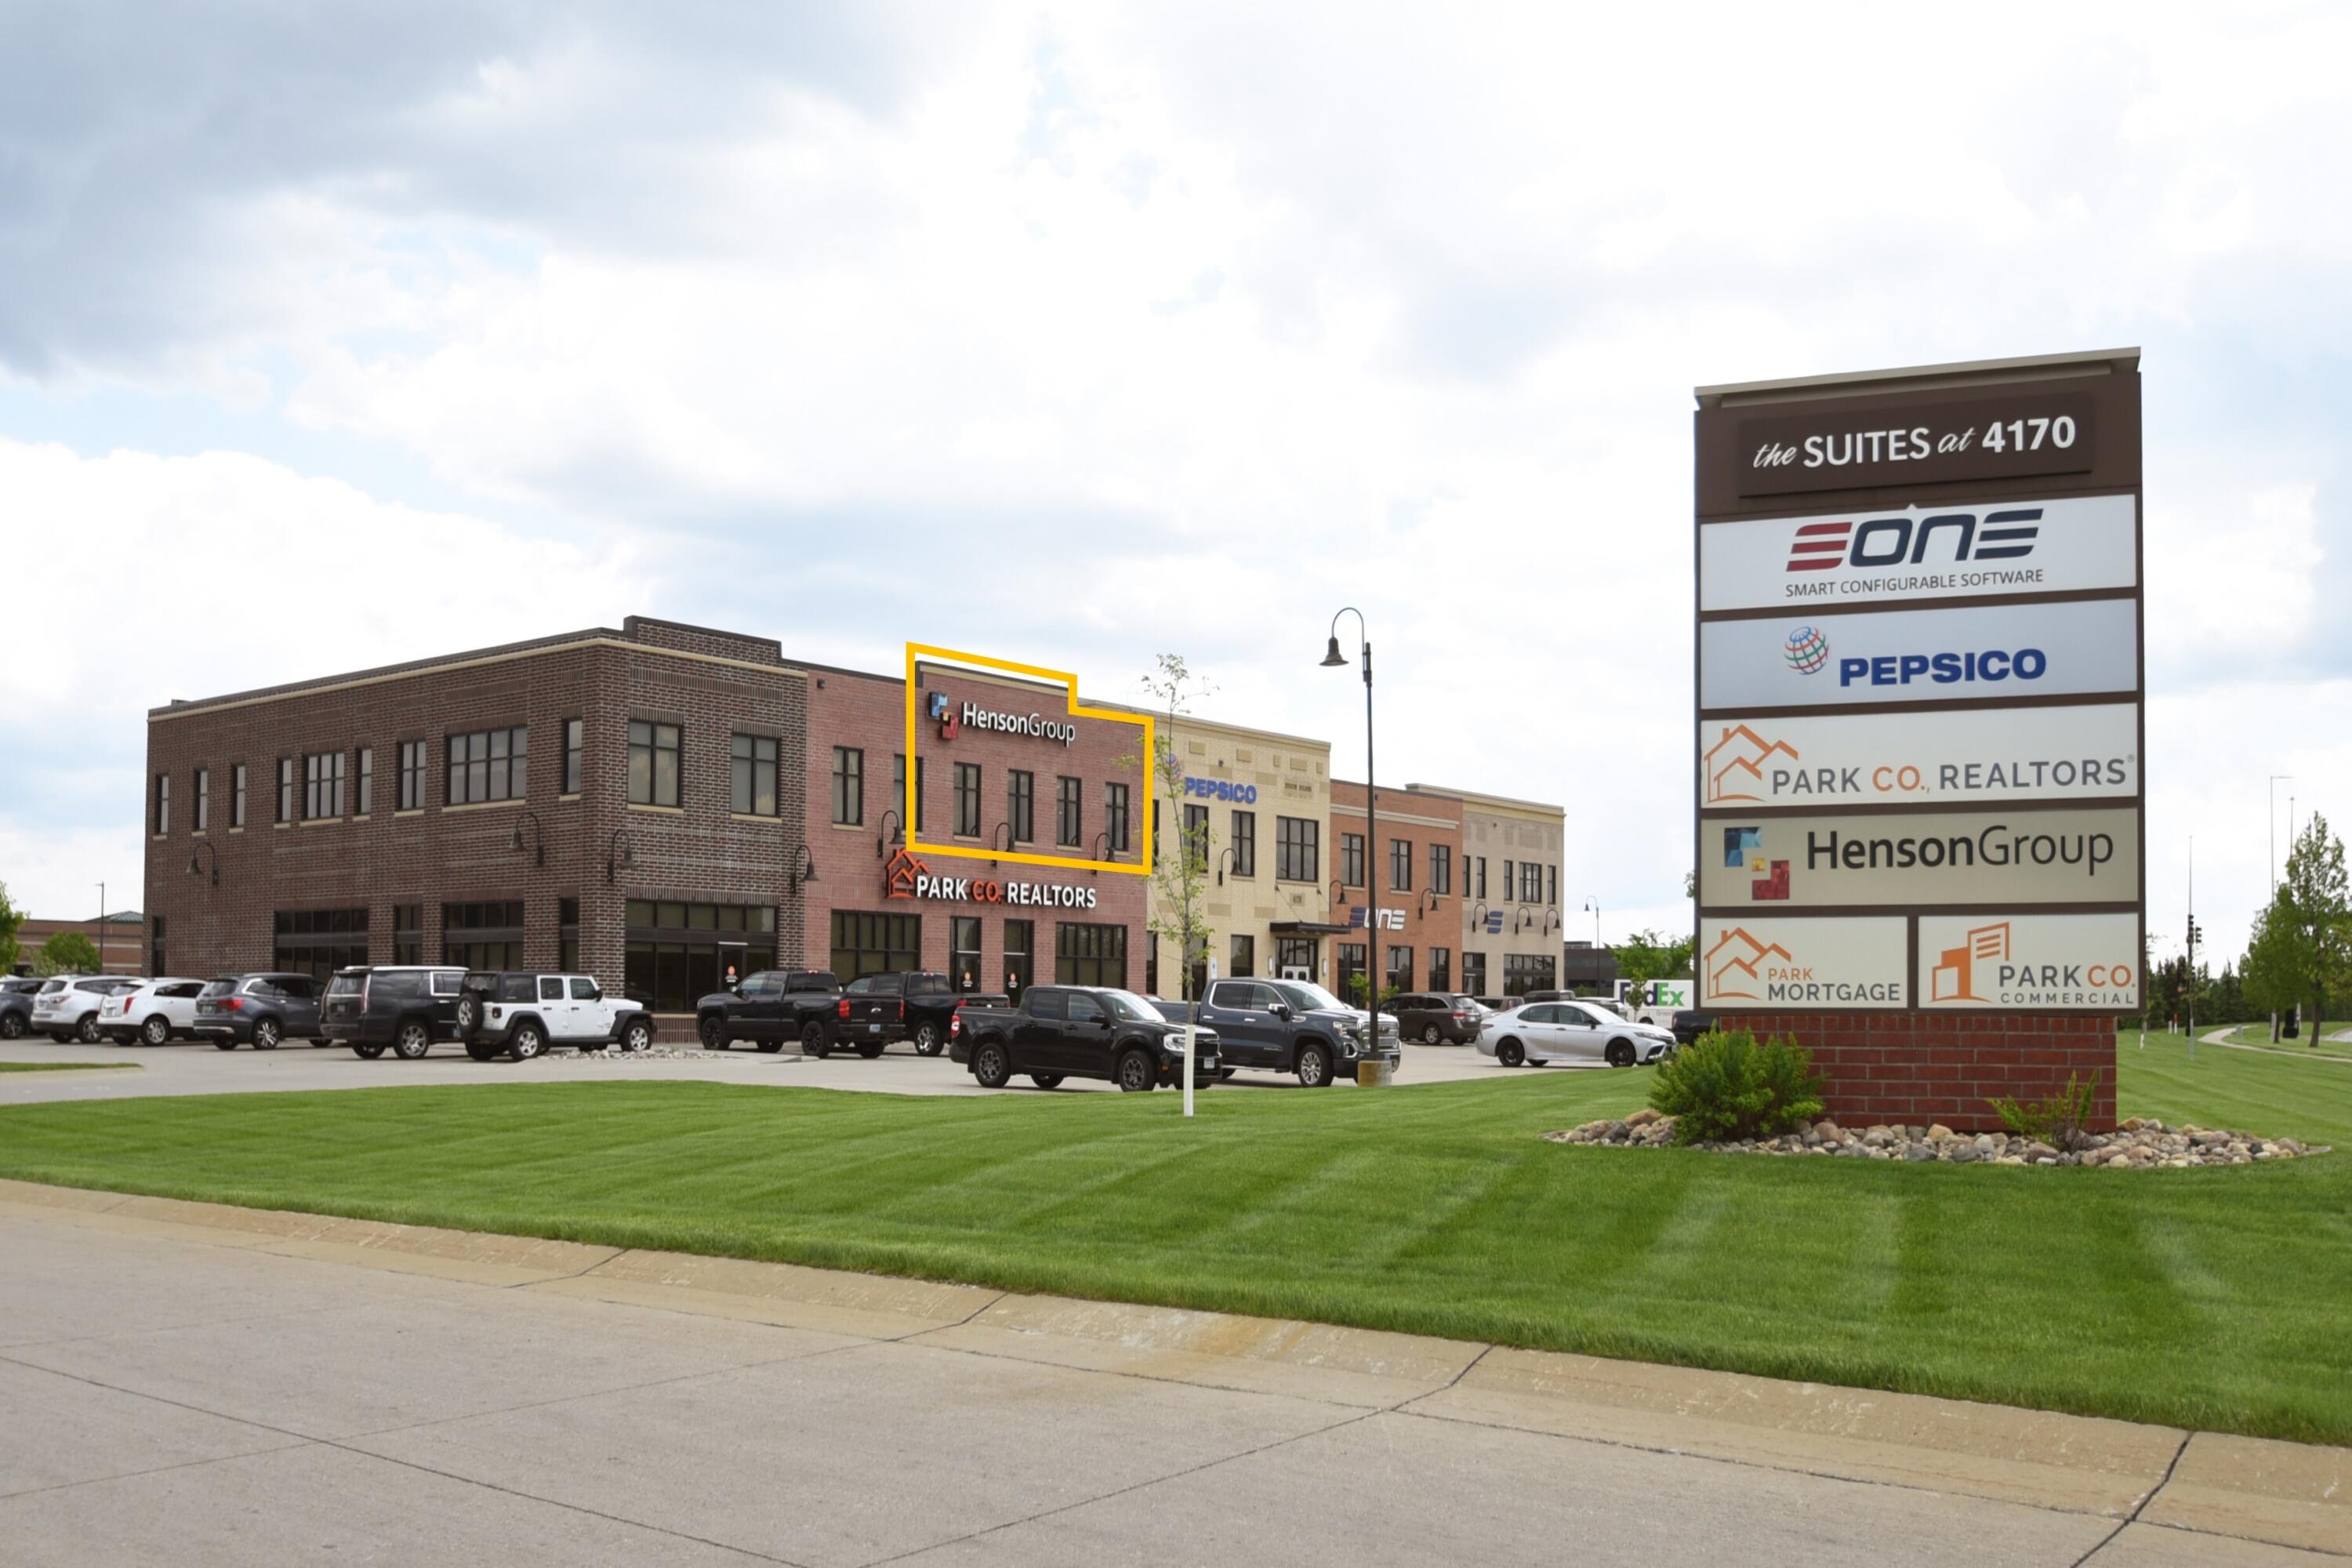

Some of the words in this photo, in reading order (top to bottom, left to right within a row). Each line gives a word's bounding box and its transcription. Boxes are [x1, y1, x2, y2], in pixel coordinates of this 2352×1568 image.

[1753, 442, 1796, 468] the
[1803, 427, 1930, 467] SUITES
[1938, 428, 1976, 453] at
[1982, 416, 2075, 453] 4170
[1785, 582, 1836, 597] SMART
[1840, 575, 1956, 594] CONFIGURABLE
[1961, 569, 2044, 588] SOFTWARE
[1840, 648, 2046, 687] PEPSICO
[962, 702, 1076, 748] HensonGroup
[1185, 776, 1257, 804] PEPSICO
[1772, 768, 1861, 795] PARK
[1807, 826, 2114, 877] HensonGroup
[916, 876, 967, 901] PARK
[1007, 882, 1096, 909] REALTORS
[1768, 967, 1813, 981] PARK
[1998, 965, 2082, 988] PARK
[2087, 965, 2136, 987] CO.
[1620, 982, 1685, 1007] FdEx
[1768, 984, 1900, 1001] MORTGAGE
[2001, 993, 2134, 1004] COMMERCIAL
